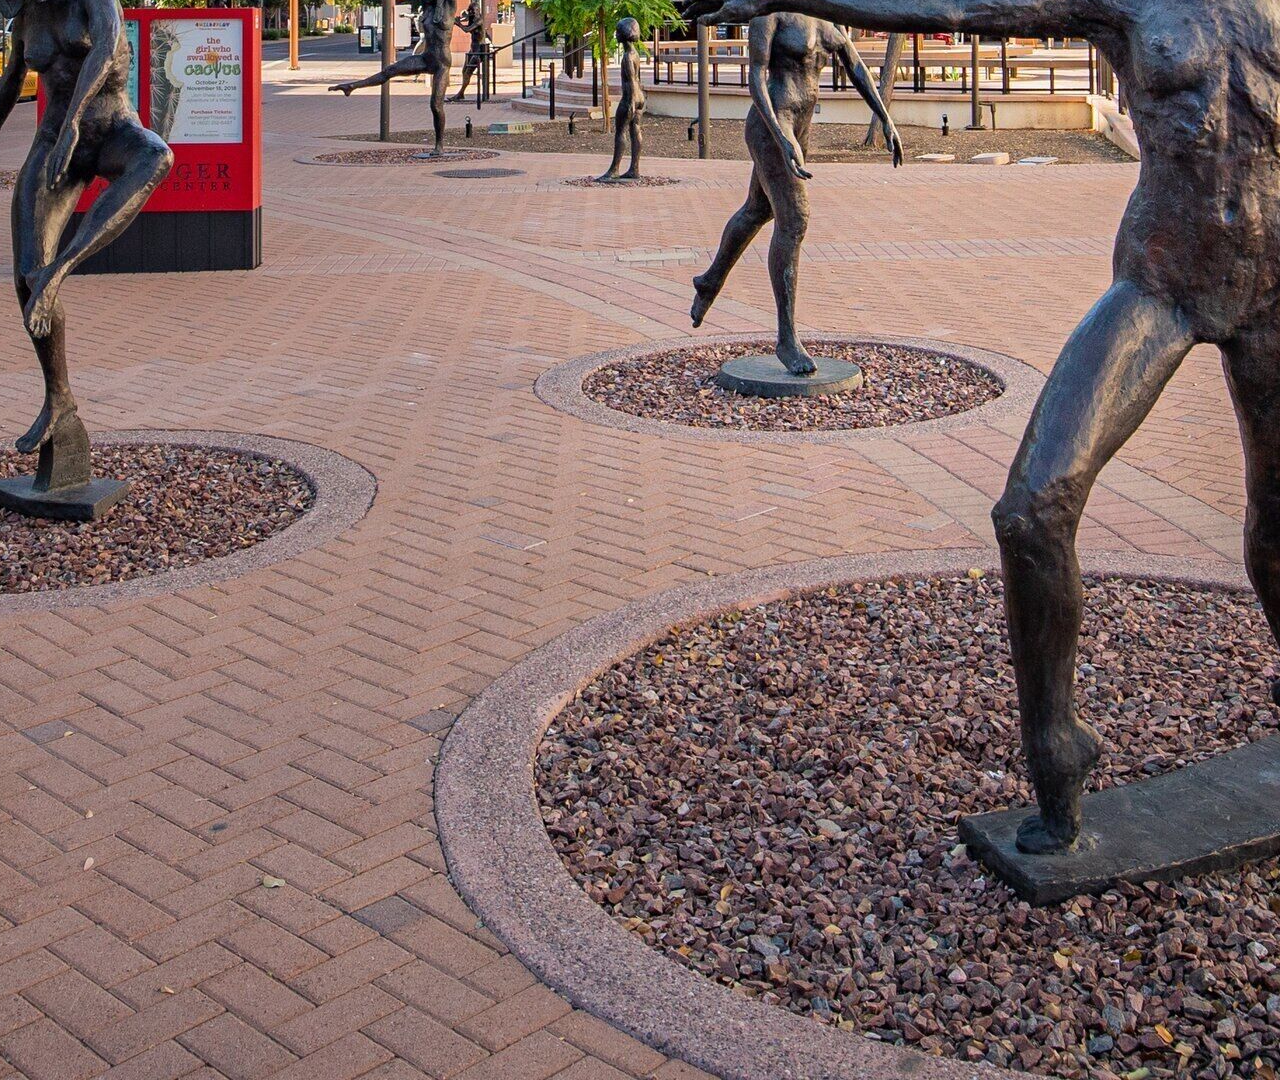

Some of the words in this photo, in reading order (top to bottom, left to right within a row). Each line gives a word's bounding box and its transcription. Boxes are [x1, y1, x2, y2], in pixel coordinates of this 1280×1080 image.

[206, 37, 221, 45] the
[195, 45, 211, 54] girl
[212, 45, 231, 53] who
[186, 53, 233, 61] swallowed
